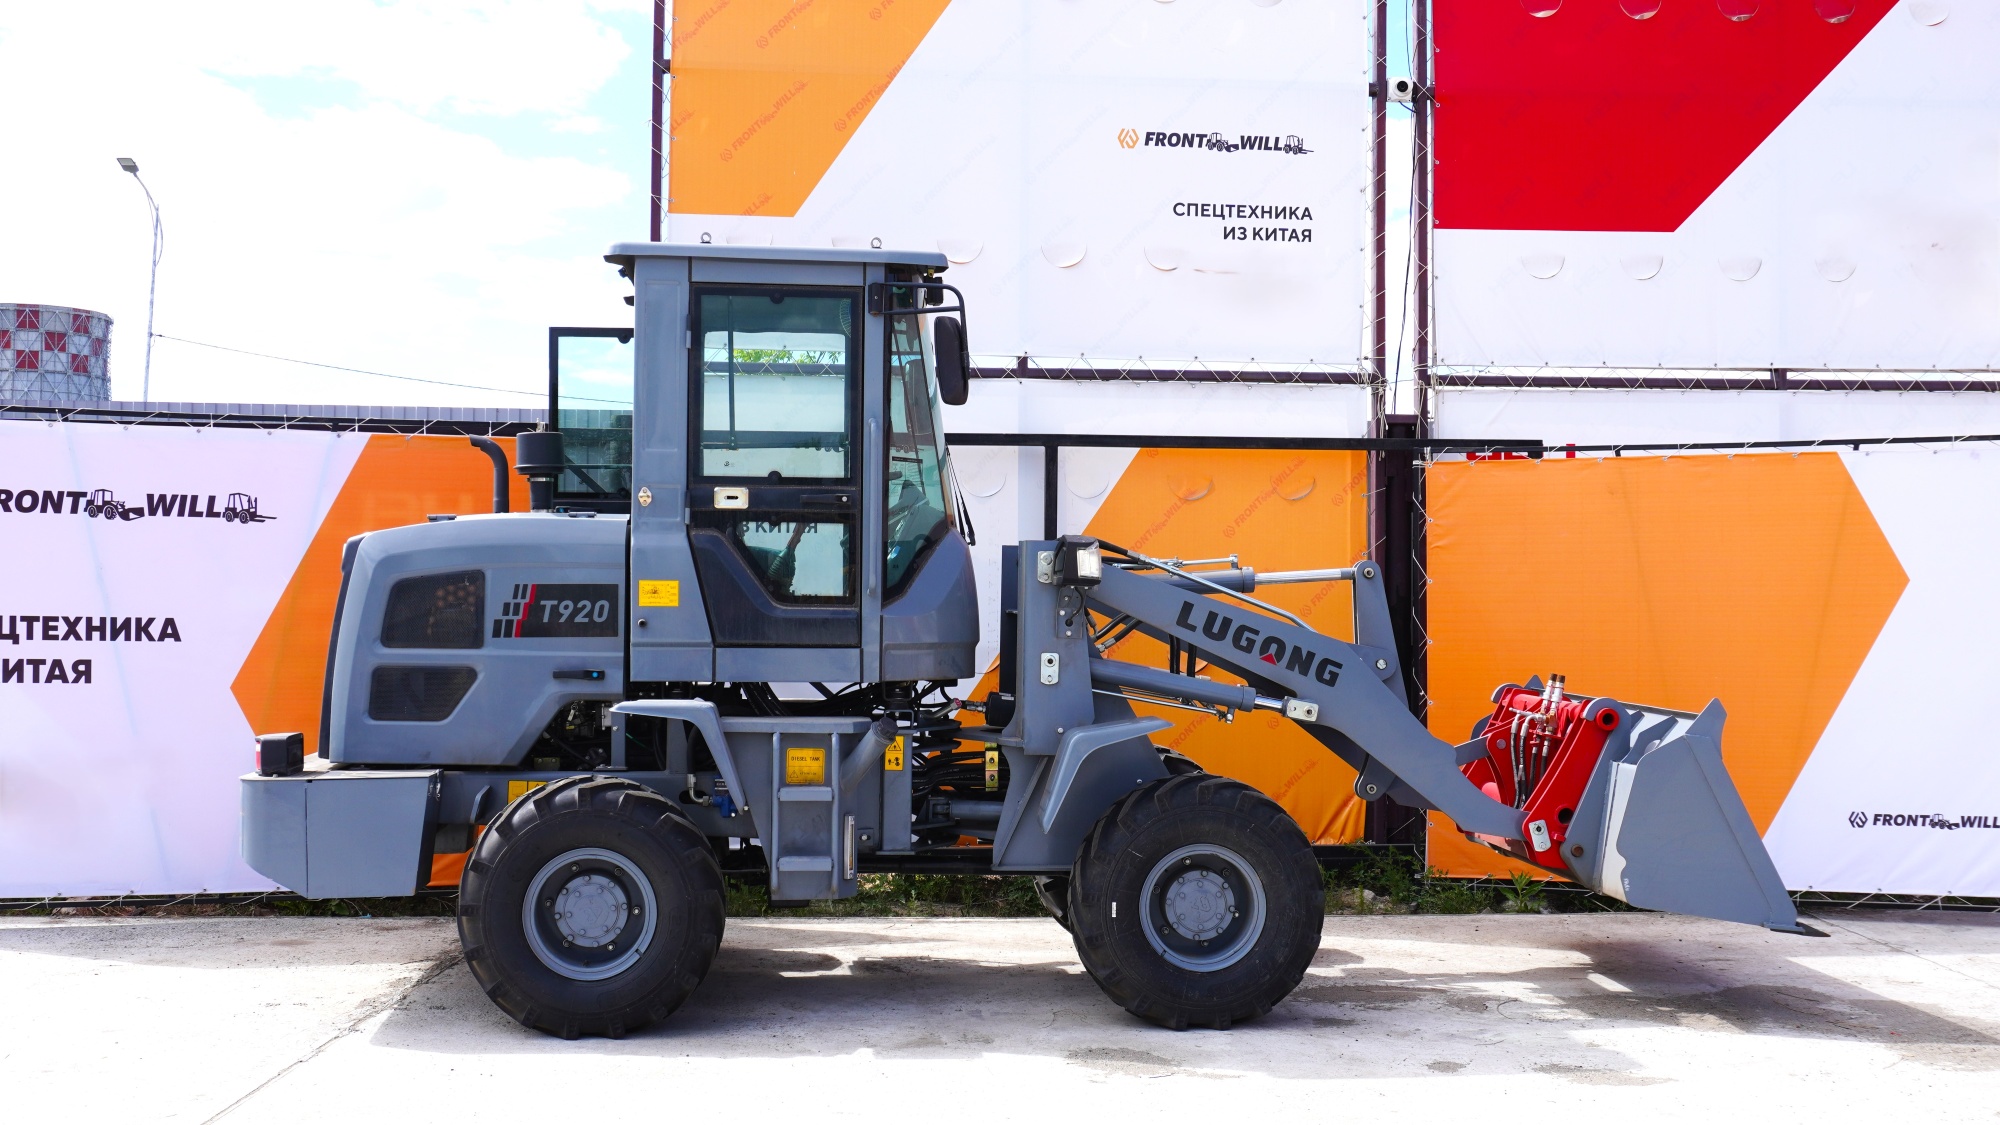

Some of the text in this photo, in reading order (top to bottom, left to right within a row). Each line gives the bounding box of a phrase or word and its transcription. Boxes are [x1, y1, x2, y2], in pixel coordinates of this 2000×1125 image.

[732, 120, 762, 151] FRONT
[1145, 131, 1283, 151] FRONT WILL
[1172, 202, 1313, 221] СПЕЦТЕХНИКА
[1223, 226, 1312, 243] ИЗ КИТАЯ
[146, 493, 222, 519] WILL
[540, 599, 609, 623] T920
[0, 615, 182, 645] ЦТЕХНИКА
[1175, 600, 1343, 688] LUGONG
[1872, 813, 1930, 827] FRONT
